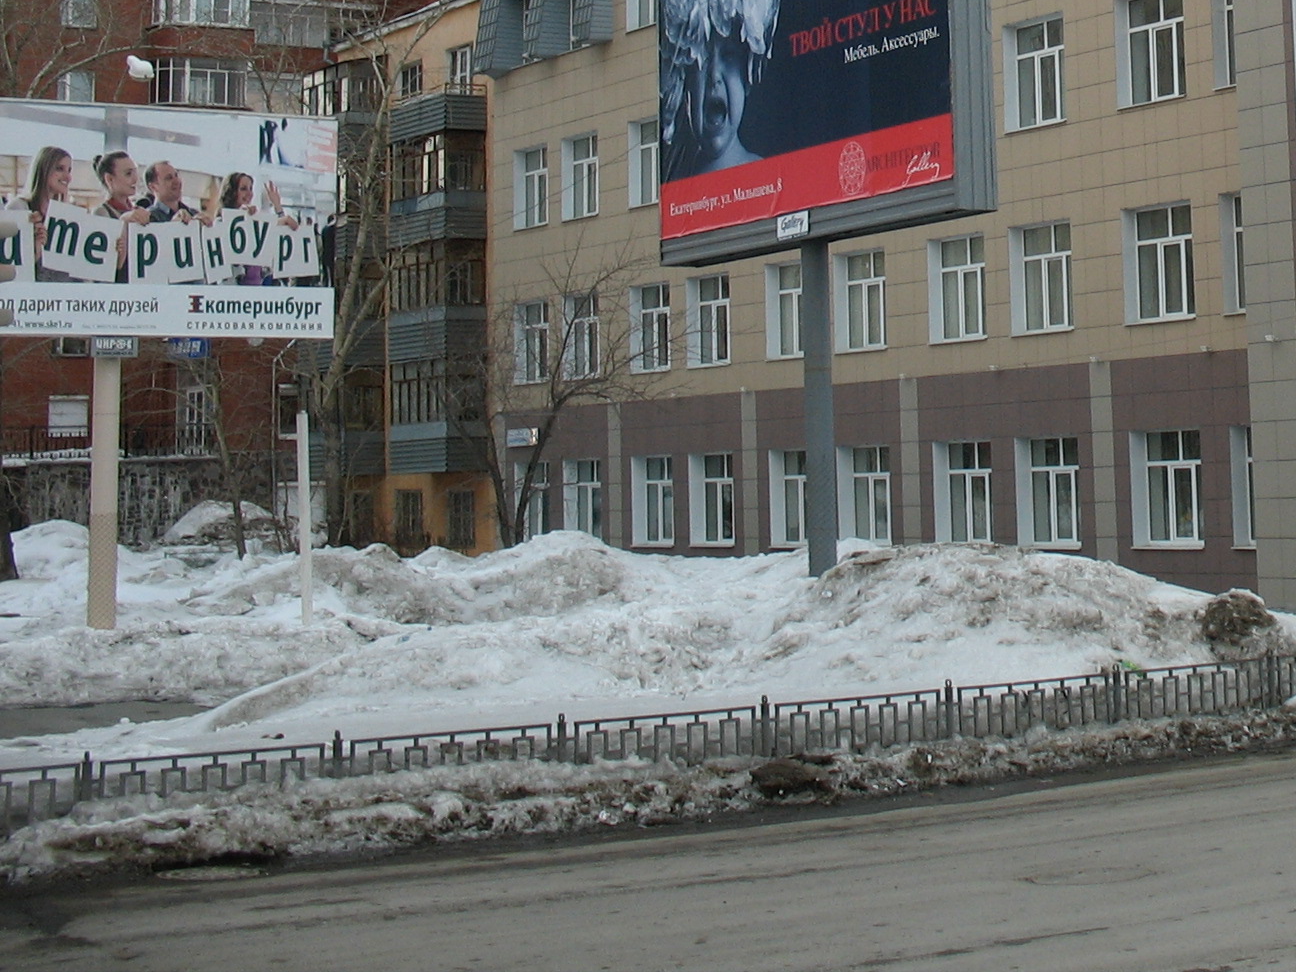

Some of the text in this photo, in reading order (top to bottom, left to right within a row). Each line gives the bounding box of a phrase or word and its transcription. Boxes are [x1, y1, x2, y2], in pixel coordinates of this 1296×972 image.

[789, 16, 832, 56] ТВОЙ
[835, 7, 880, 42] СТУЛ
[883, 1, 896, 27] У
[18, 298, 63, 316] дарит
[66, 299, 106, 313] таких
[108, 297, 159, 317] друзей
[188, 294, 323, 320] Екатеринбург
[187, 321, 323, 331] СТРАХОВАЯ КОМПАНИЯ
